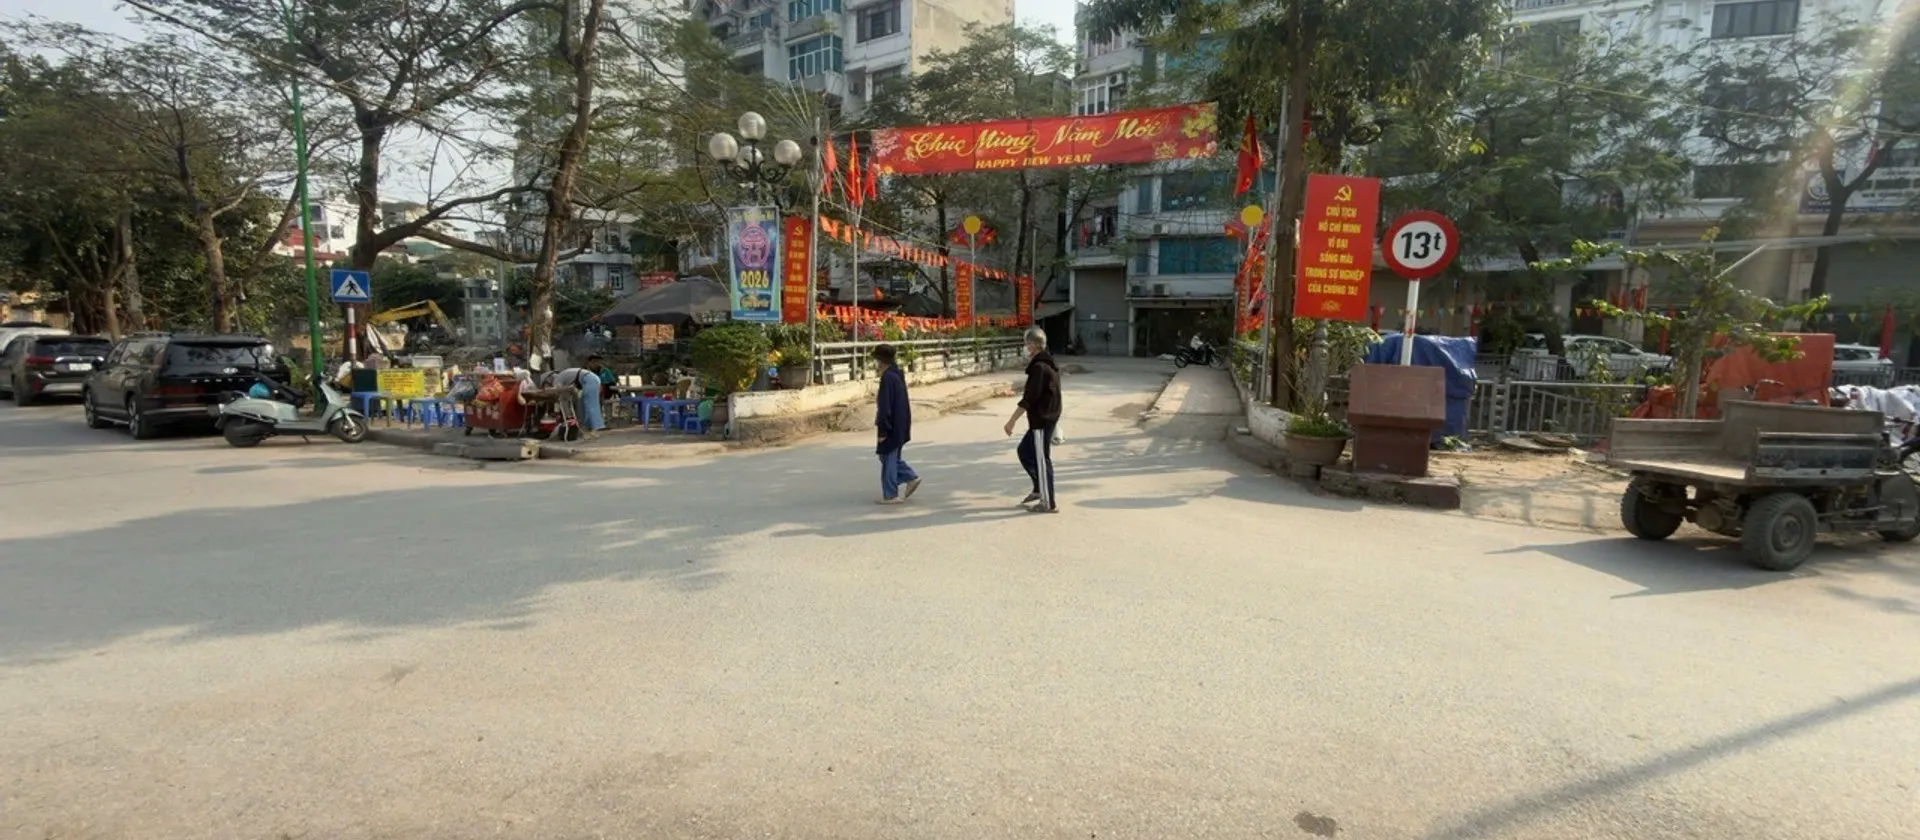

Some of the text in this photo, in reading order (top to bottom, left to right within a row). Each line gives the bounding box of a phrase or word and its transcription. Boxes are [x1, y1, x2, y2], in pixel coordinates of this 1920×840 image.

[910, 132, 969, 158] Chúc
[1042, 118, 1104, 150] Năm
[1108, 114, 1166, 142] Mới
[976, 158, 1017, 168] HAPPY
[1057, 153, 1092, 165] YEAR
[1401, 231, 1442, 259] 13t
[740, 270, 769, 288] 2026
